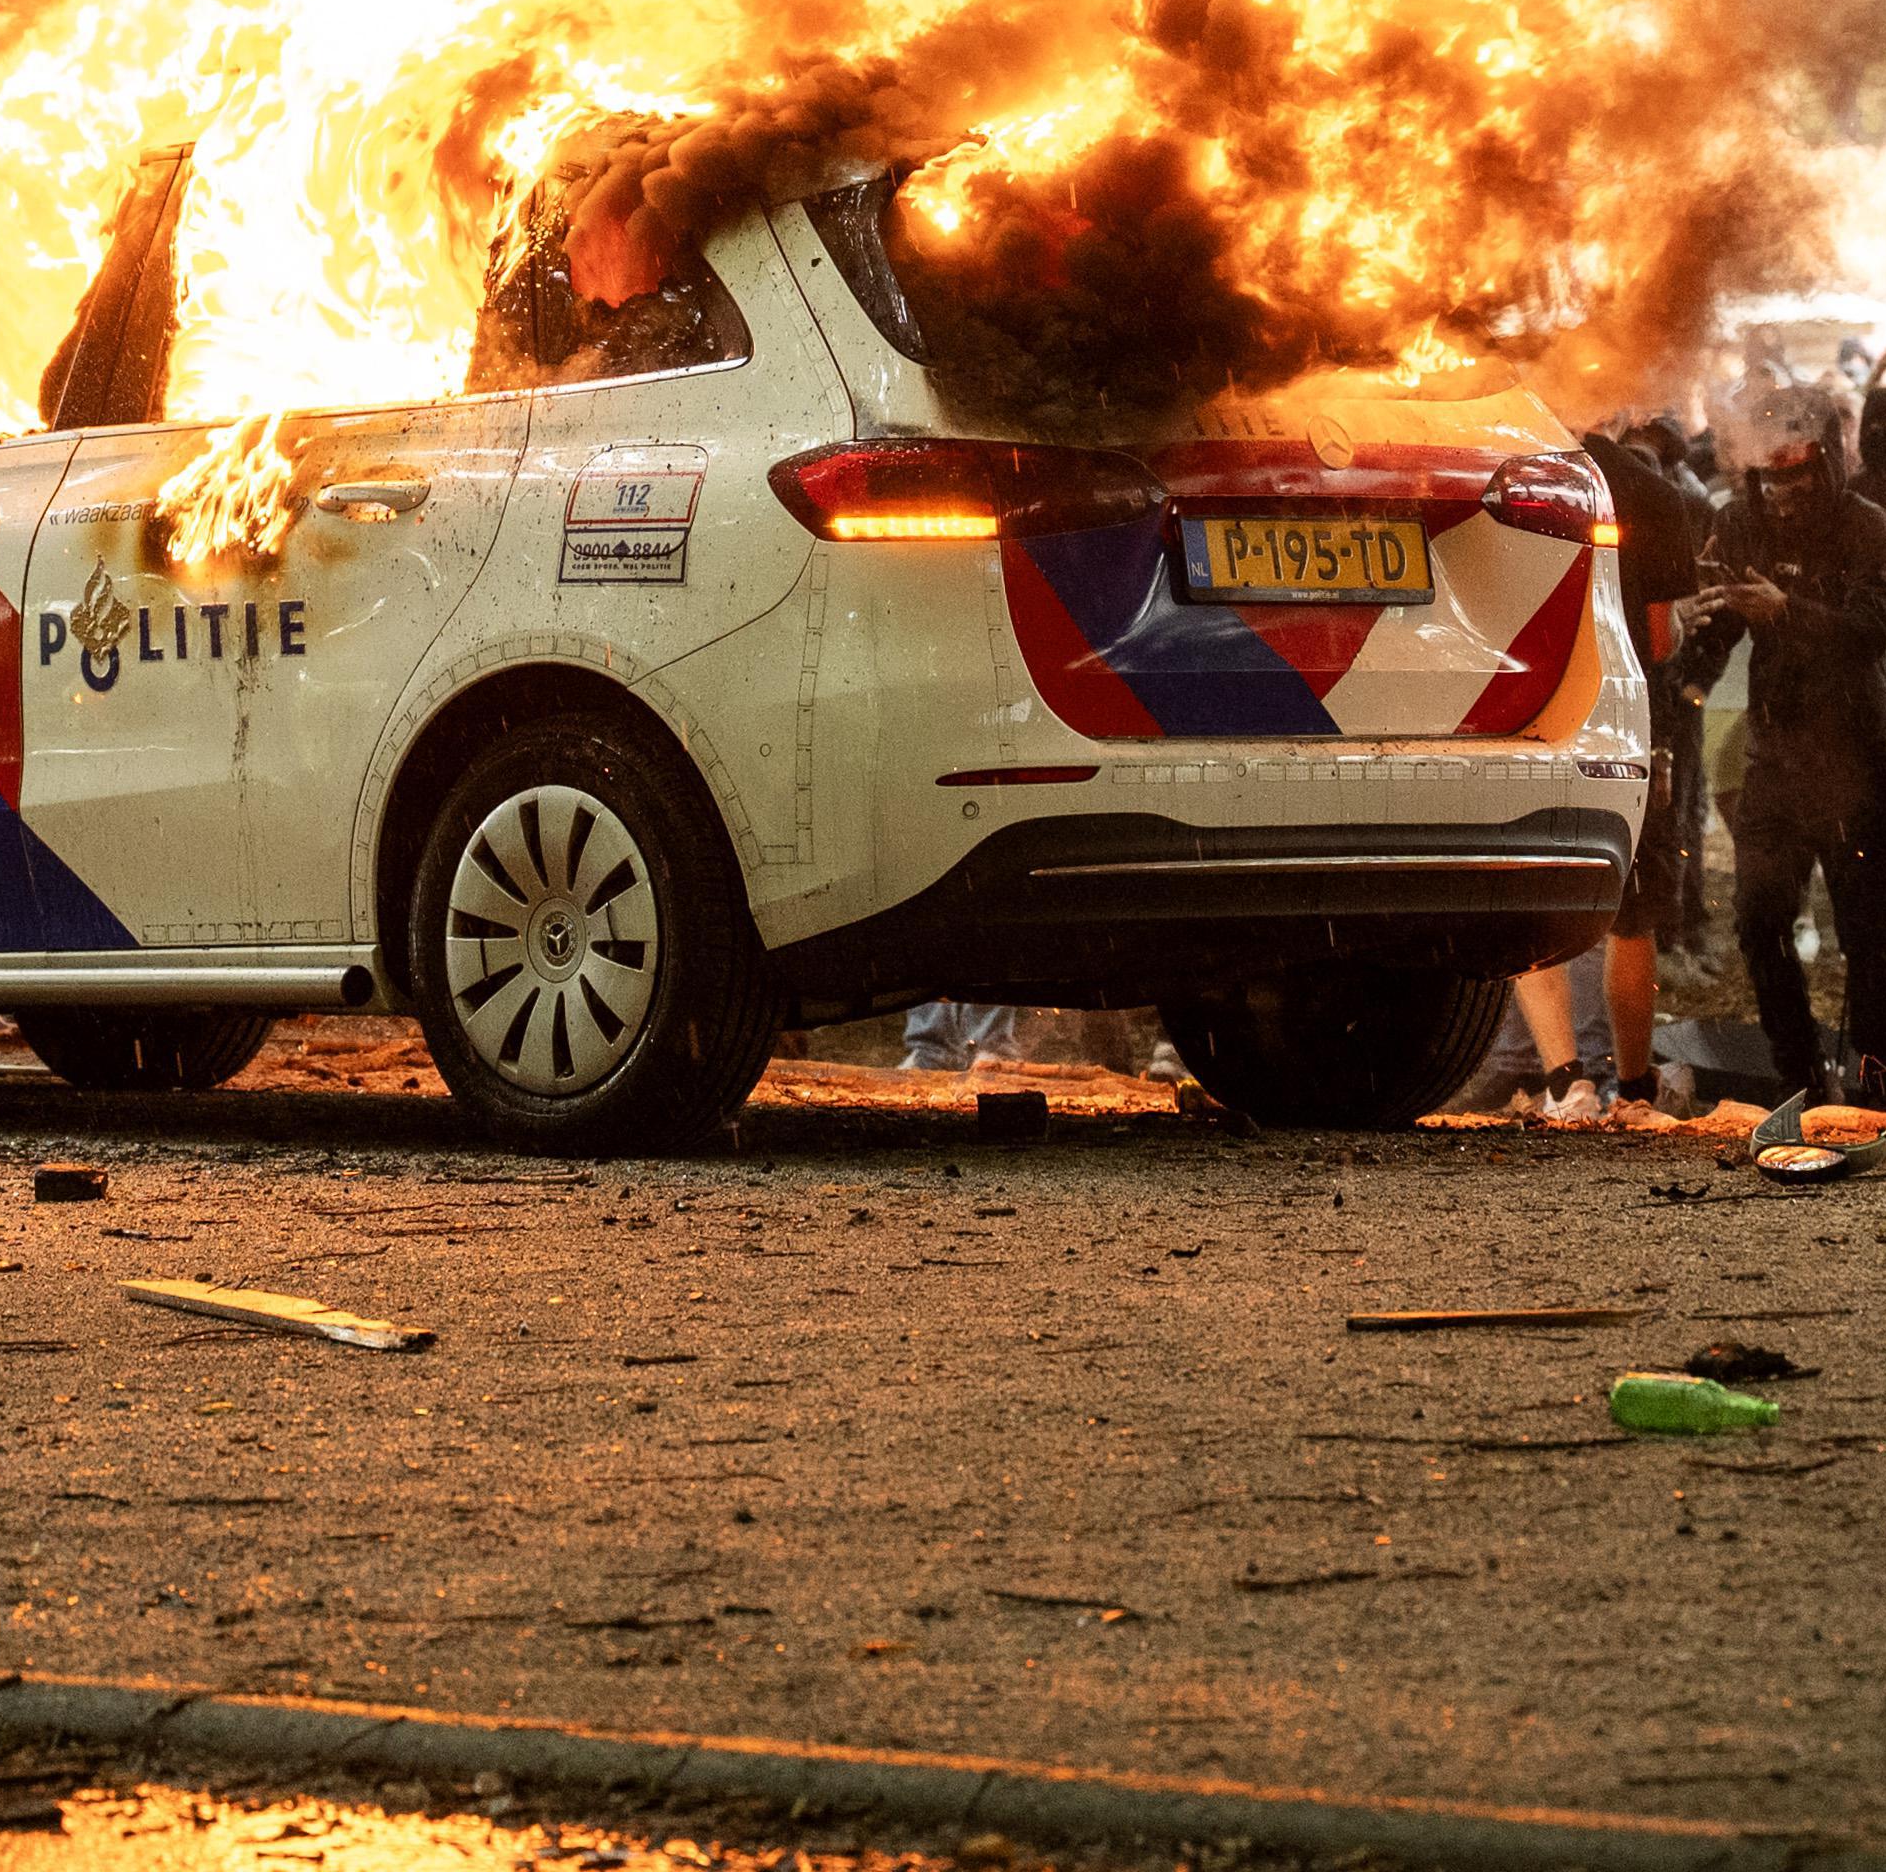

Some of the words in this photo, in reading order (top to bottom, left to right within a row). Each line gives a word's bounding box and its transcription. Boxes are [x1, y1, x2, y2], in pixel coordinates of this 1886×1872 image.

[573, 543, 610, 560] 0900
[633, 542, 671, 560] 8844
[1225, 529, 1407, 581] P-195-TD
[1191, 562, 1209, 577] NL
[40, 600, 306, 692] POLITIE
